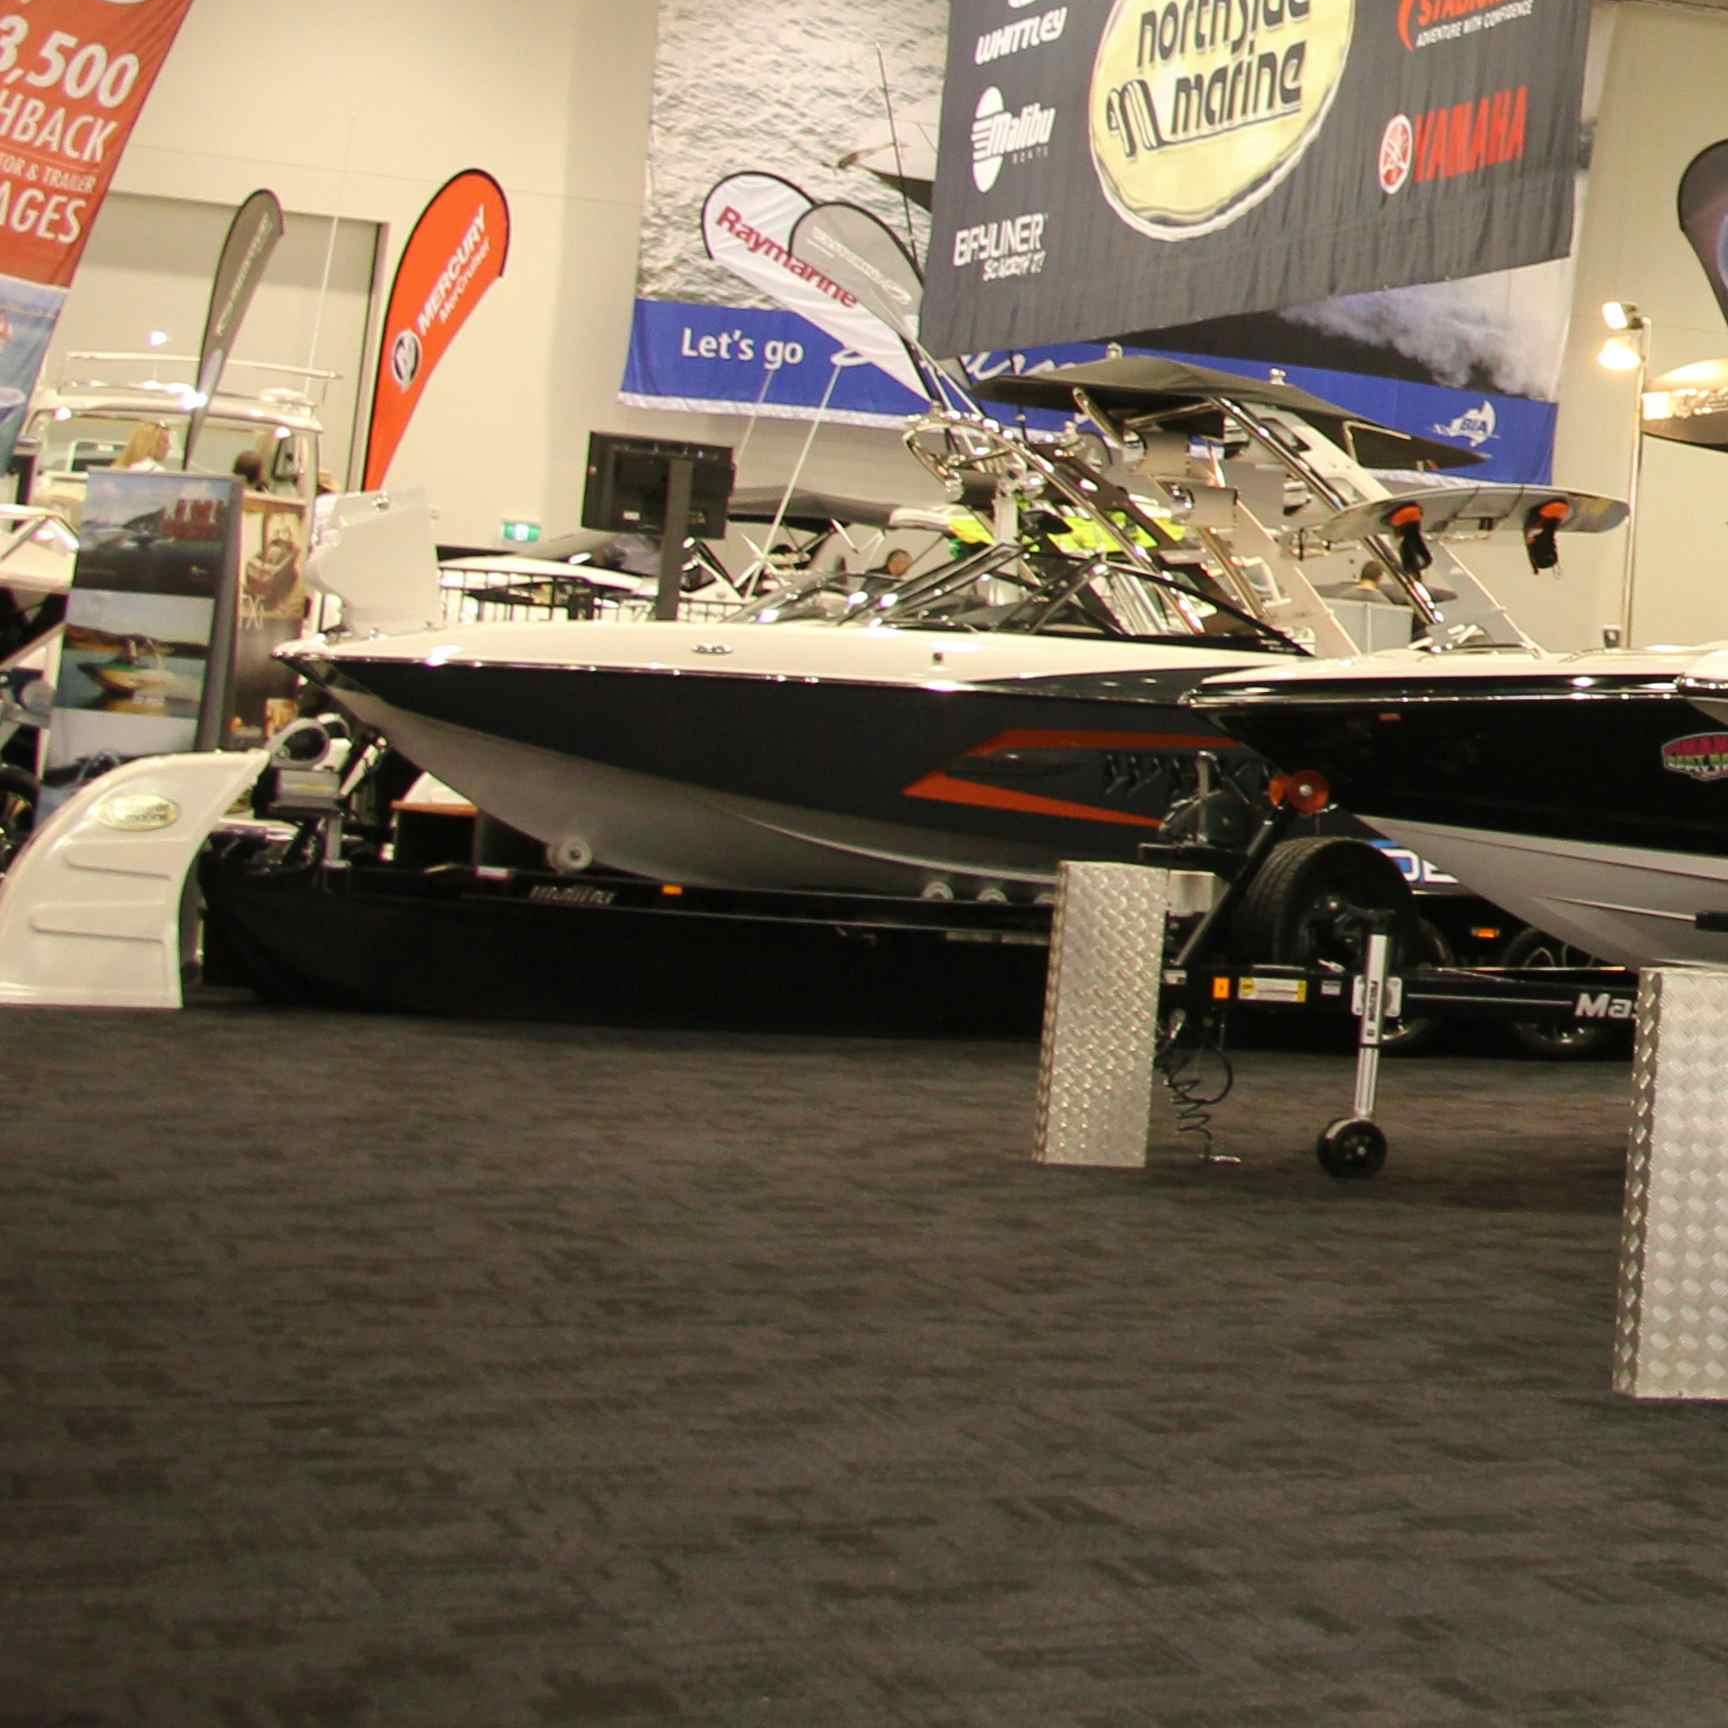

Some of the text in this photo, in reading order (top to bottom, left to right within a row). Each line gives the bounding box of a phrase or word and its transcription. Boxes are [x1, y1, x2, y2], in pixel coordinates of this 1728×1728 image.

[975, 7, 1067, 65] WHITTLEY
[1171, 40, 1306, 134] marine
[985, 102, 1056, 156] Malibu
[1414, 86, 1527, 183] YAMAHA
[418, 203, 486, 336] MERCURY
[716, 206, 859, 308] Raymarine
[953, 213, 1045, 266] BAYLINER
[681, 326, 755, 362] Let's
[764, 340, 803, 370] go
